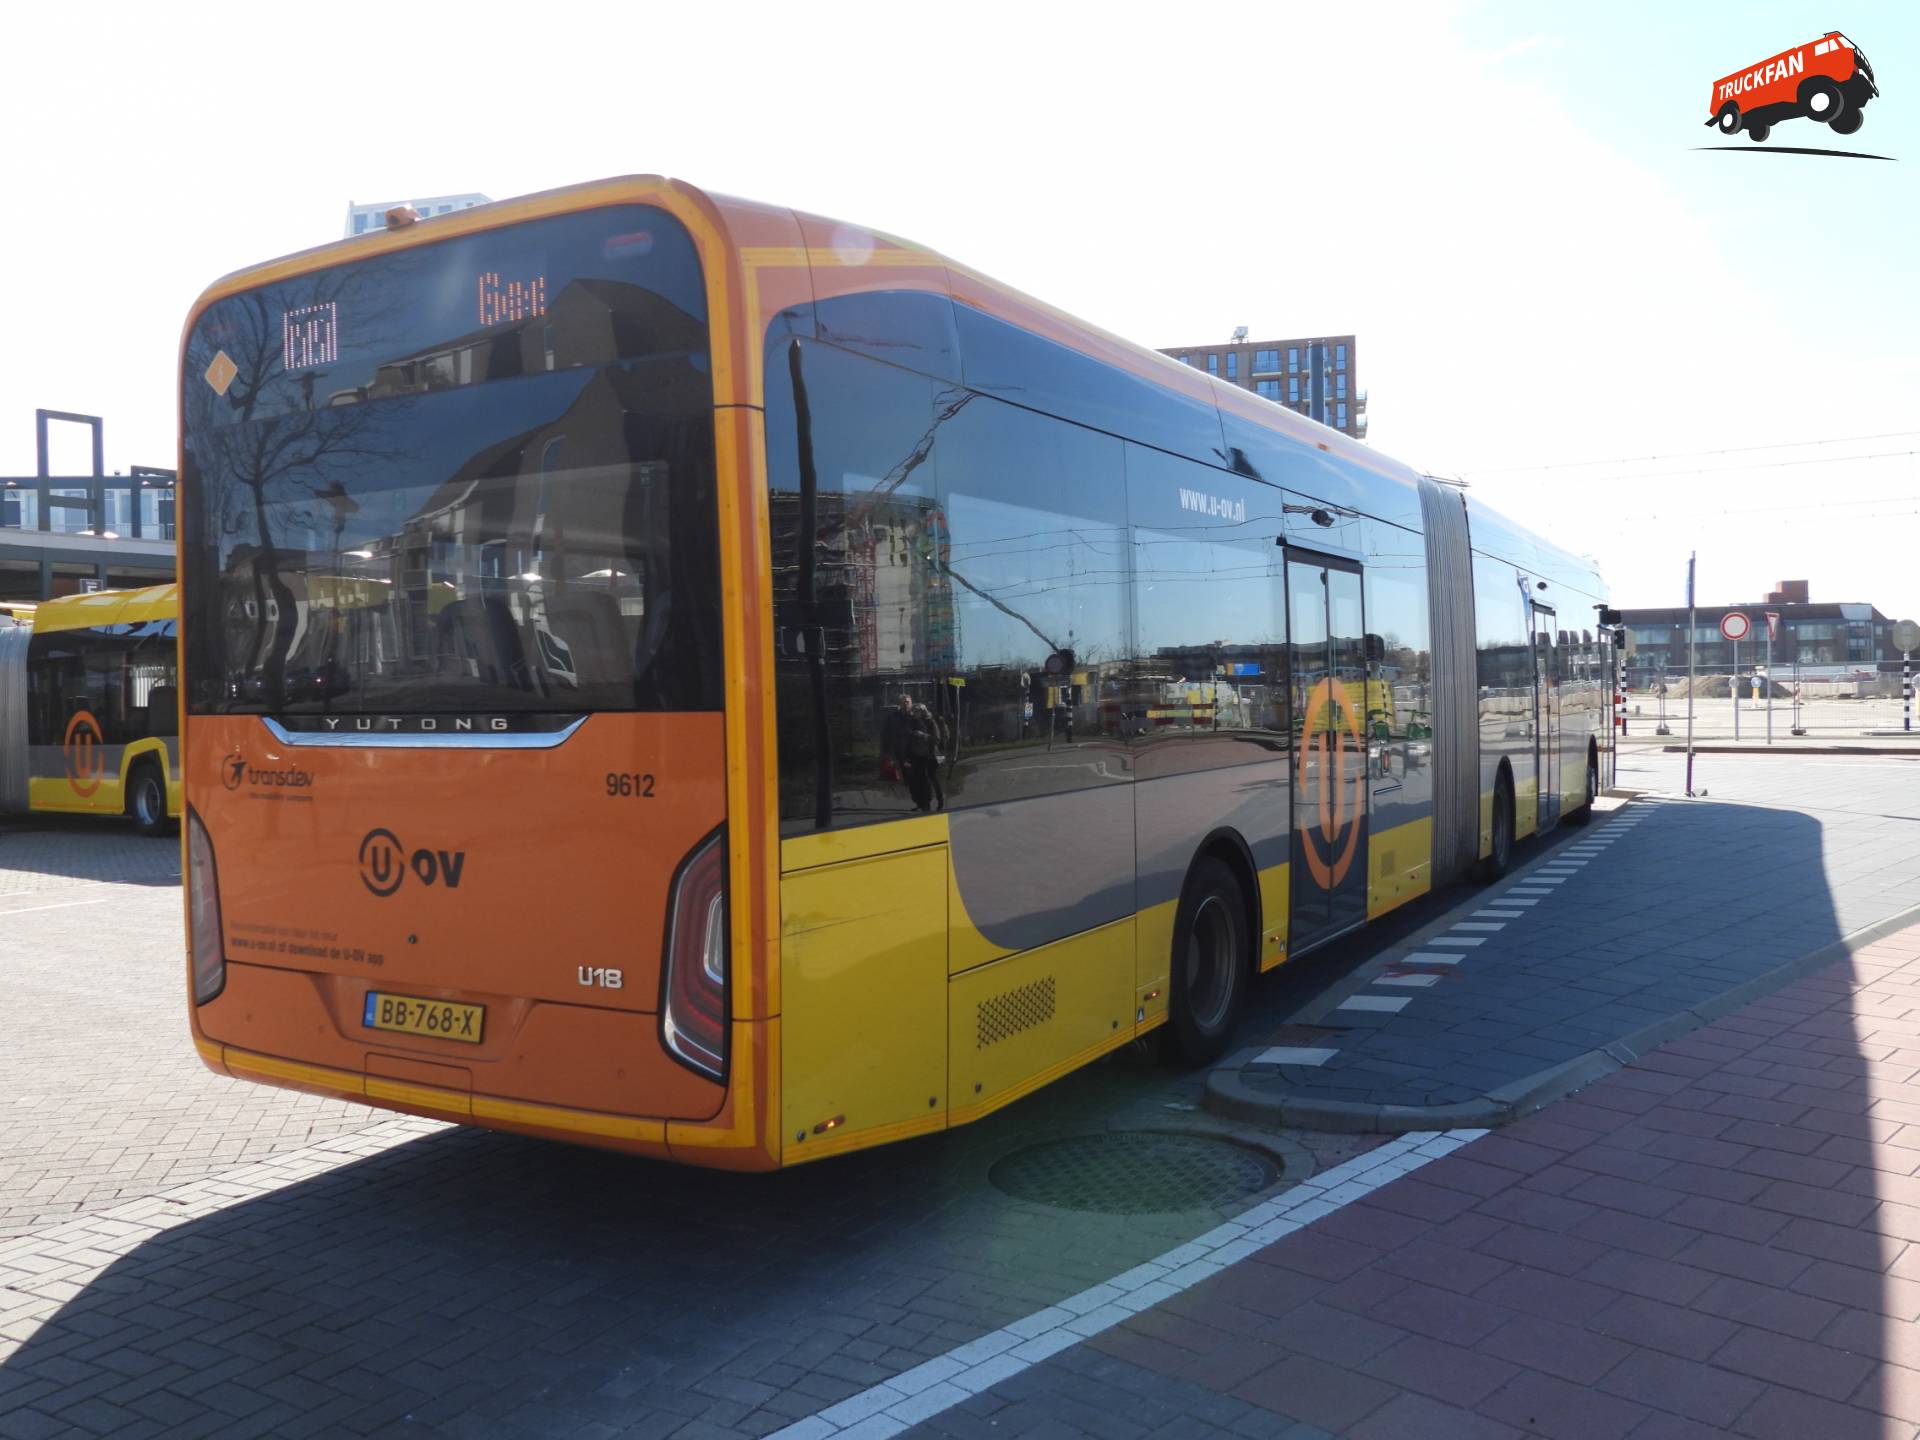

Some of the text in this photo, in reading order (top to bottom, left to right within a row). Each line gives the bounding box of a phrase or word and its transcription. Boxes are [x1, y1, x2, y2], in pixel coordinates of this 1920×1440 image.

[1179, 488, 1245, 522] www.u-ov.nl
[326, 718, 508, 730] YUTONG
[248, 766, 314, 787] transdev
[606, 773, 655, 797] 9612
[578, 966, 622, 988] U18
[382, 1000, 474, 1035] BB-768-X
